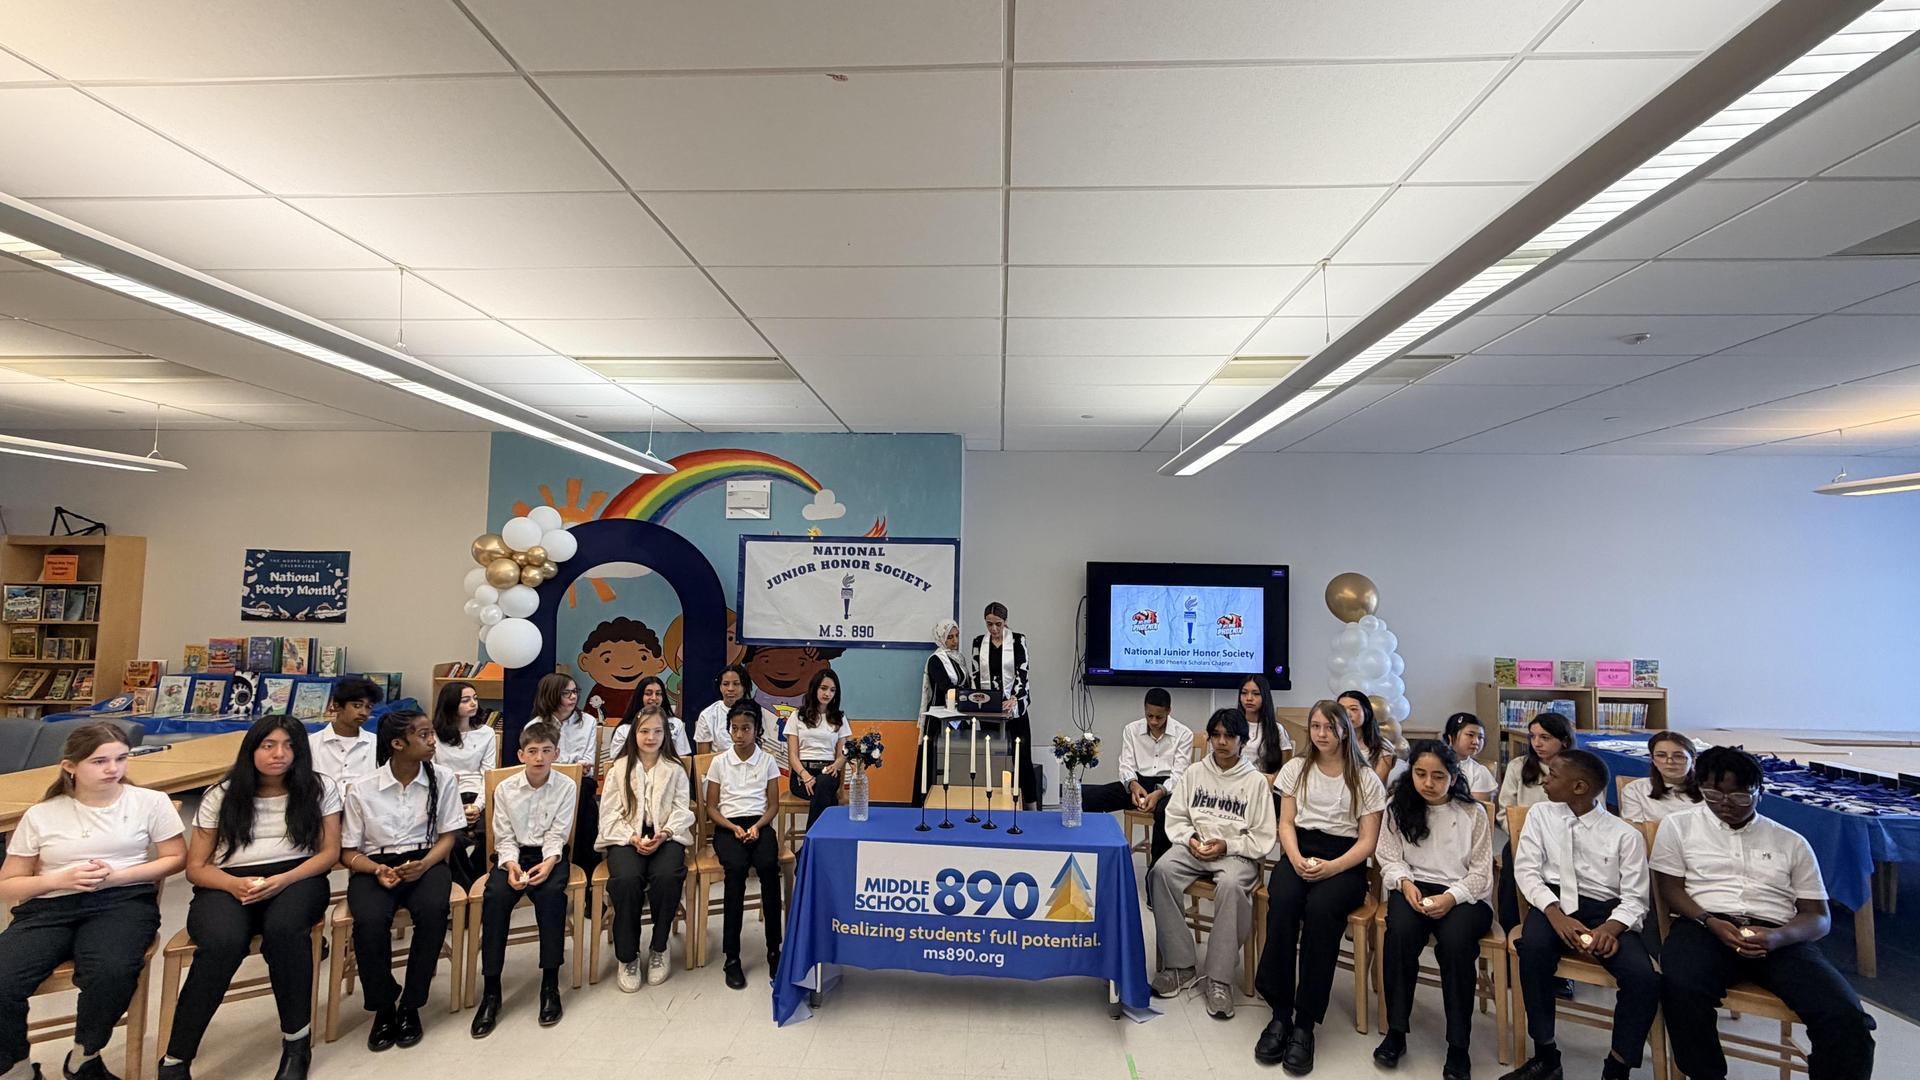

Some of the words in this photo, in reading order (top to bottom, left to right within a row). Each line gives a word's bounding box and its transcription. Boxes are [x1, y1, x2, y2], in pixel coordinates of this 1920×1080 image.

[813, 546, 886, 557] NATIONAL
[270, 571, 320, 583] National
[766, 563, 817, 590] JUNIOR
[820, 559, 870, 570] HONOR
[874, 562, 932, 592] SOCIETY
[255, 584, 294, 598] Poetry
[296, 585, 337, 596] Month
[819, 625, 847, 638] M.S.
[851, 625, 874, 638] 890
[1124, 647, 1162, 656] National
[1163, 648, 1191, 657] Junior
[1192, 649, 1221, 657] Honor
[1222, 650, 1255, 660] Society
[1191, 789, 1218, 809] NEW
[1217, 796, 1248, 820] YORK
[864, 877, 930, 895] MIDDLE
[933, 867, 1040, 920] 890
[855, 893, 930, 913] SCHOOL
[832, 918, 905, 942] Realizing
[909, 927, 986, 944] students'
[990, 929, 1018, 946] full
[1021, 933, 1102, 950] potential.
[923, 947, 1005, 968] ms890.org
